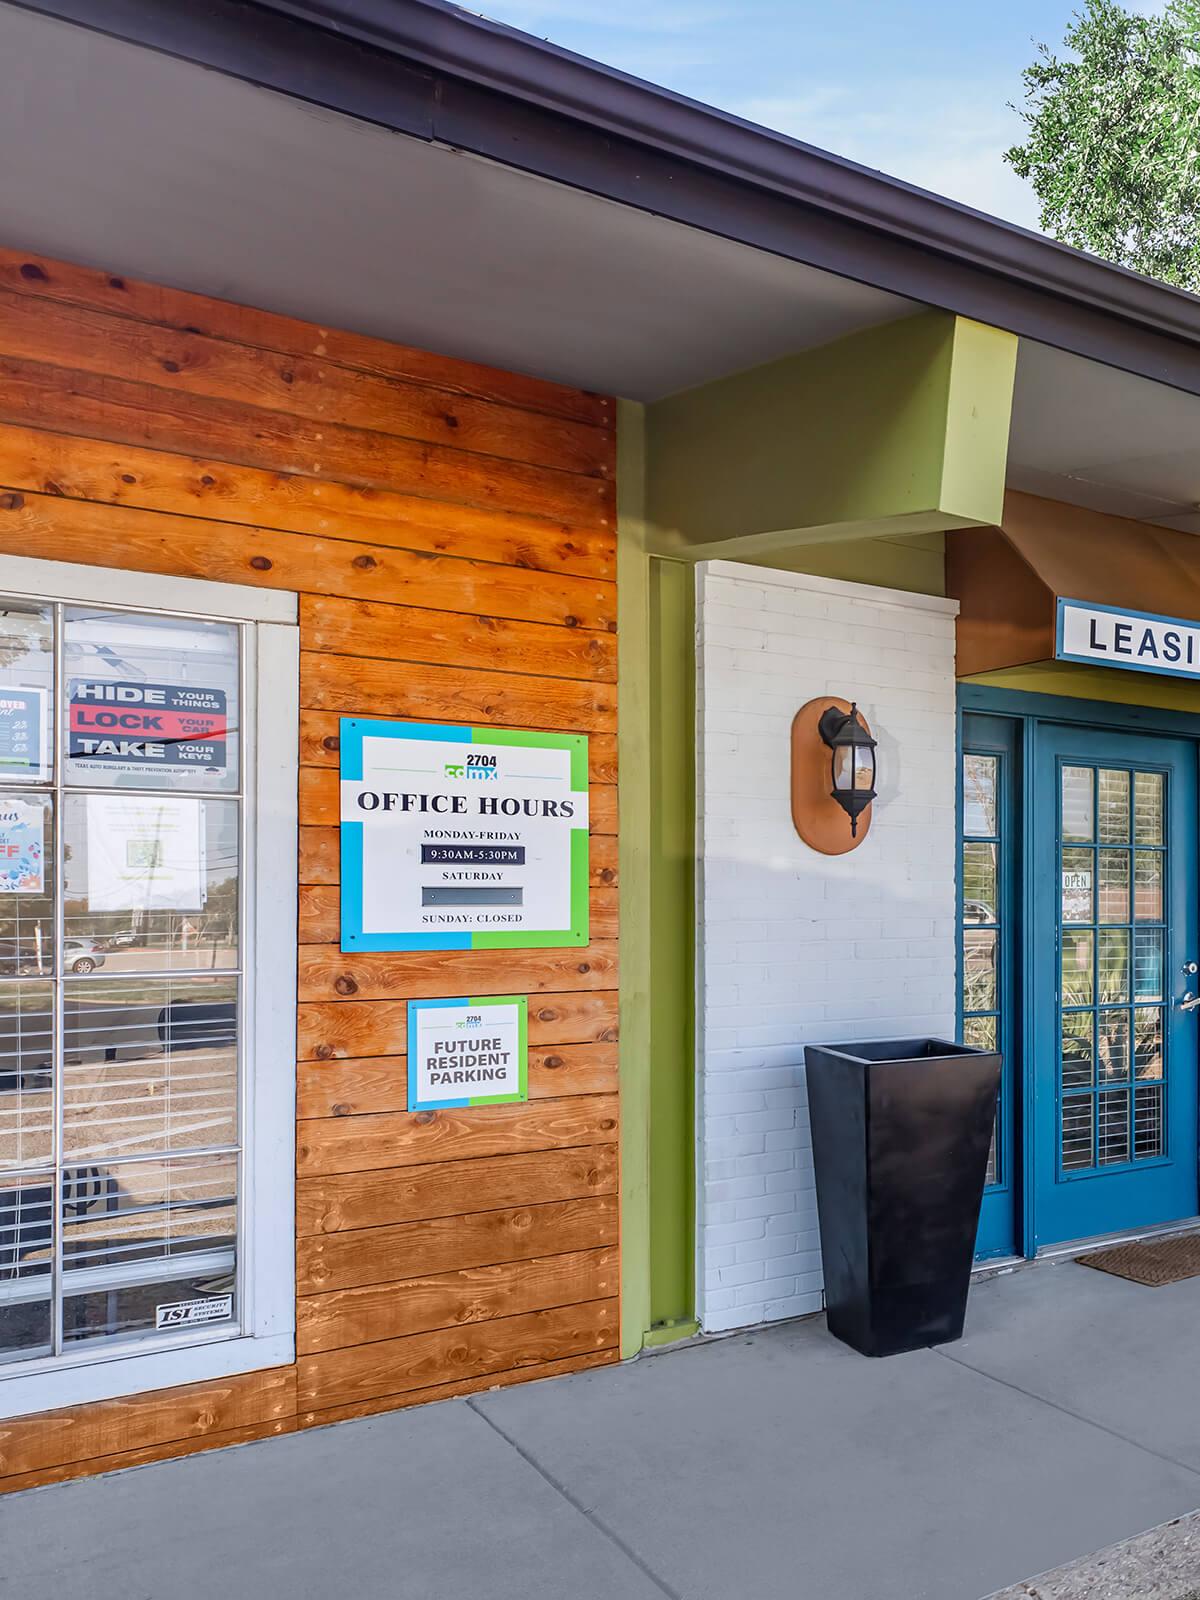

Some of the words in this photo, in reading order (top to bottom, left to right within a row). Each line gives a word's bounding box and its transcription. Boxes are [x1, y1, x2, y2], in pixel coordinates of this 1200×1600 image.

[77, 684, 166, 704] HIDE
[177, 692, 215, 701] YOUR
[172, 699, 221, 709] THINGS
[77, 711, 164, 730] LOCK
[178, 718, 214, 726] YOUR
[182, 726, 210, 734] CAR
[77, 738, 165, 758] TAKE
[177, 745, 214, 753] YOUR
[179, 752, 212, 761] KEYS
[467, 754, 497, 767] 2704
[357, 791, 468, 815] OFFICE
[478, 796, 575, 818] HOURS
[423, 830, 522, 841] MONDAY-FRIDAY
[431, 850, 518, 860] 9:30AM-5:30PM
[442, 871, 504, 881] SATURDAY
[1065, 875, 1087, 887] OPEN
[422, 914, 473, 924] SUNDAY:
[476, 914, 523, 923] CLOSED
[466, 1015, 482, 1023] 2704
[434, 1038, 502, 1054] FUTURE
[427, 1052, 511, 1070] RESIDENT
[430, 1067, 507, 1085] PARKING
[194, 1302, 227, 1311] SECURITY
[161, 1307, 193, 1322] ISI
[194, 1308, 223, 1317] SYSTEMS
